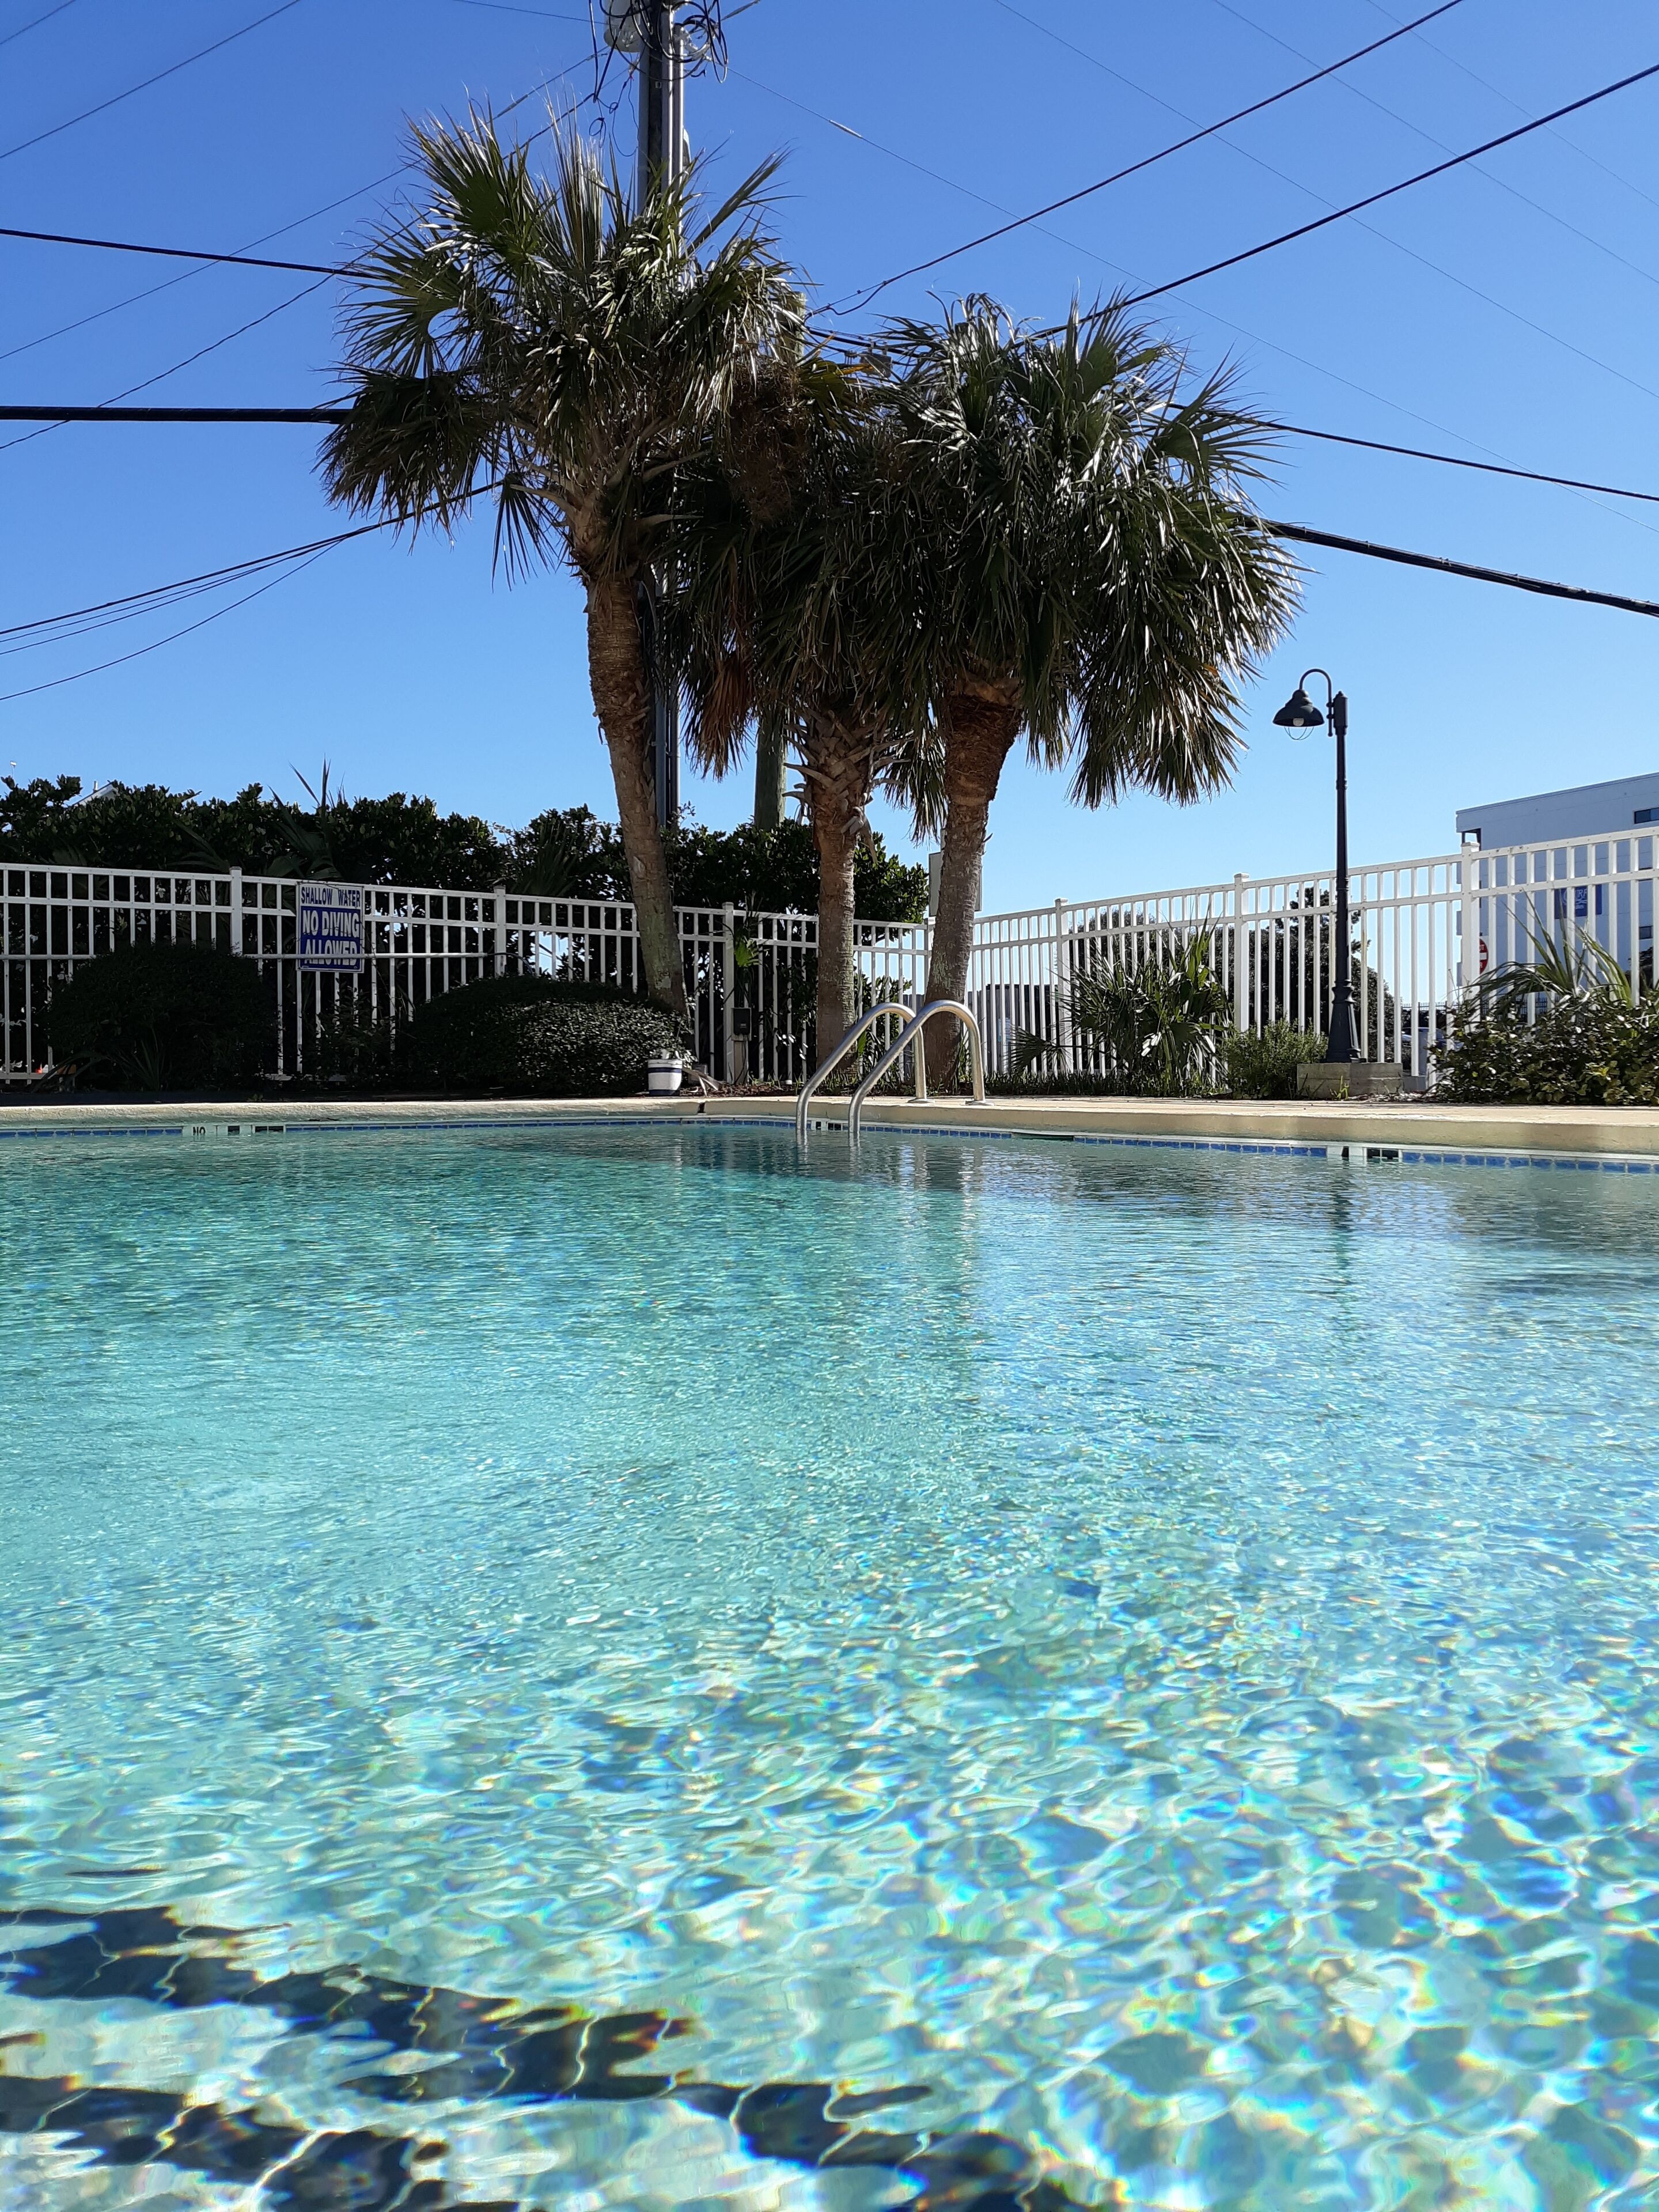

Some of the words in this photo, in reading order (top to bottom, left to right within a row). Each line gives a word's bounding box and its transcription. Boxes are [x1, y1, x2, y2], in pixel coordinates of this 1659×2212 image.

[301, 887, 333, 906] SHALLOW
[338, 889, 361, 907] WATER
[302, 910, 319, 936] NO
[321, 911, 360, 938] DIVING
[304, 939, 358, 966] ALLOWED
